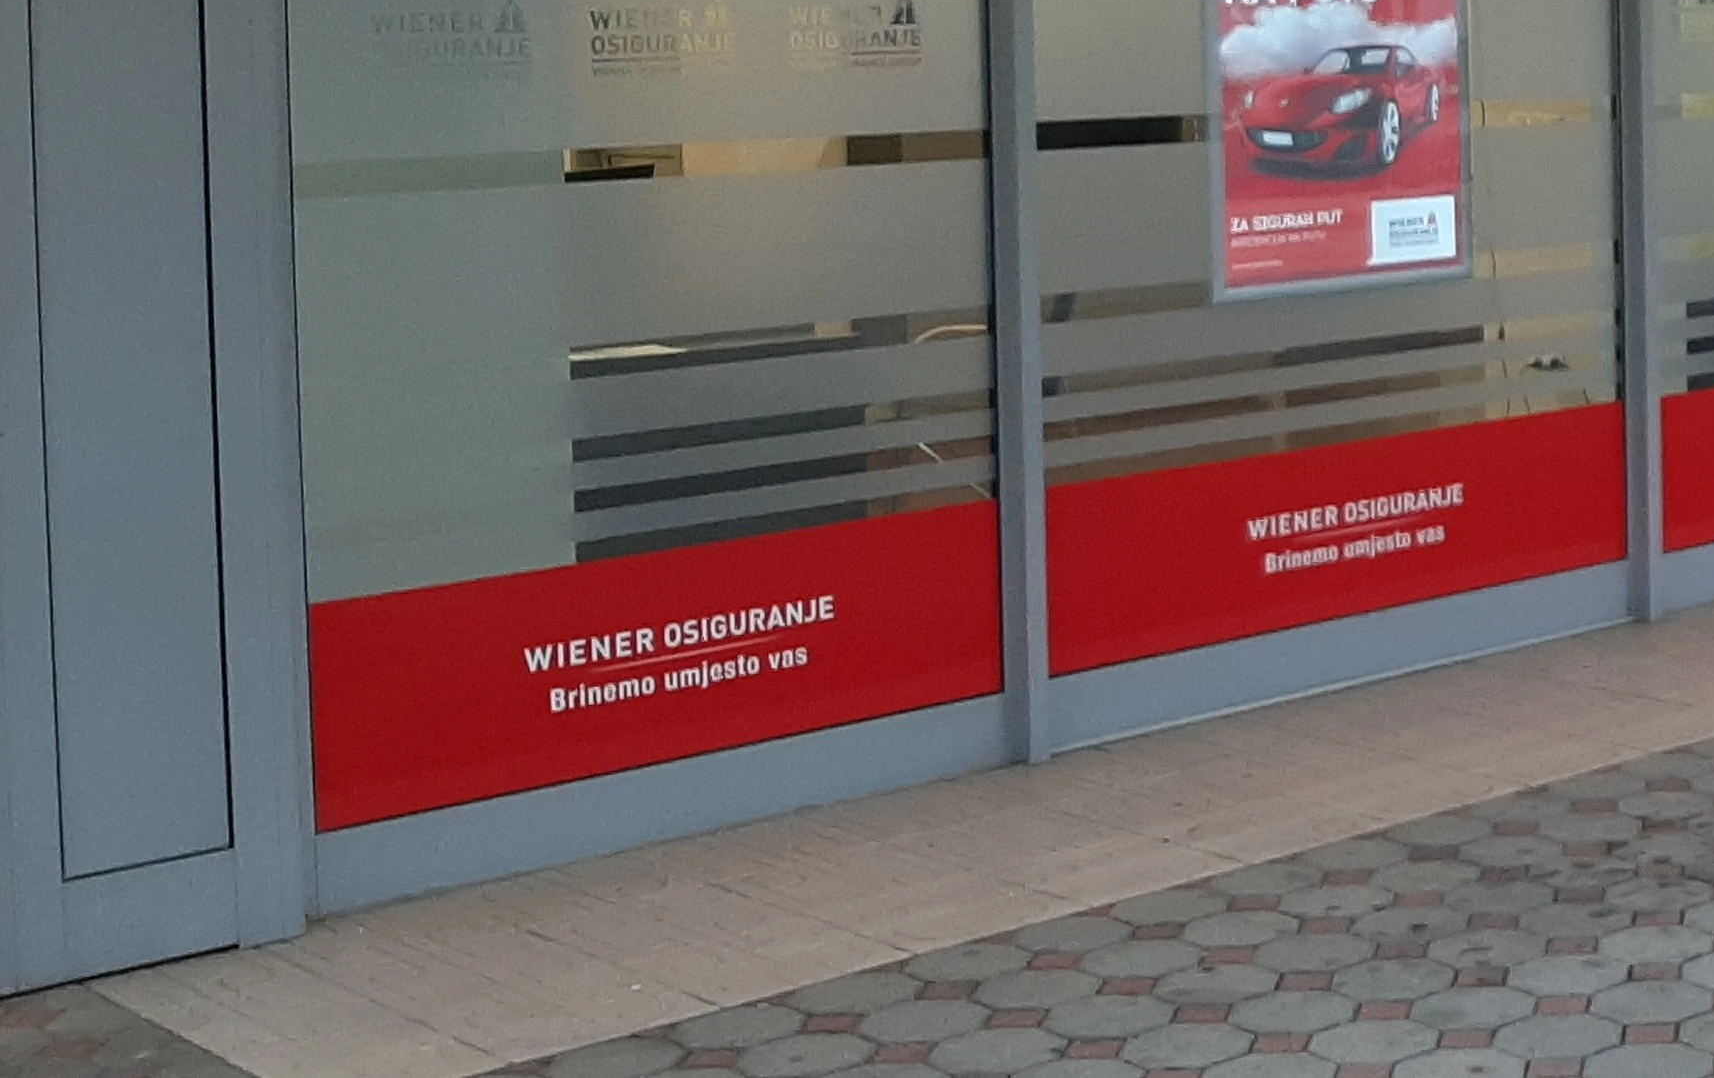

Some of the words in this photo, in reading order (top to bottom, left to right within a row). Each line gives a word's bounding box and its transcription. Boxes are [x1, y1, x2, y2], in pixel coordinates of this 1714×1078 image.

[789, 4, 882, 27] WIE
[1230, 217, 1249, 234] ZA
[1248, 505, 1338, 540] WIENER
[1344, 483, 1464, 522] OSIGURANJE
[1265, 546, 1338, 574] Brinemo
[1344, 532, 1411, 559] umjesto
[1416, 525, 1445, 544] vas
[524, 628, 655, 673] WIENER
[663, 595, 835, 648] OSIGURANJE
[550, 676, 656, 712] Brinemo
[664, 654, 760, 690] umjesto
[768, 646, 809, 671] vas
